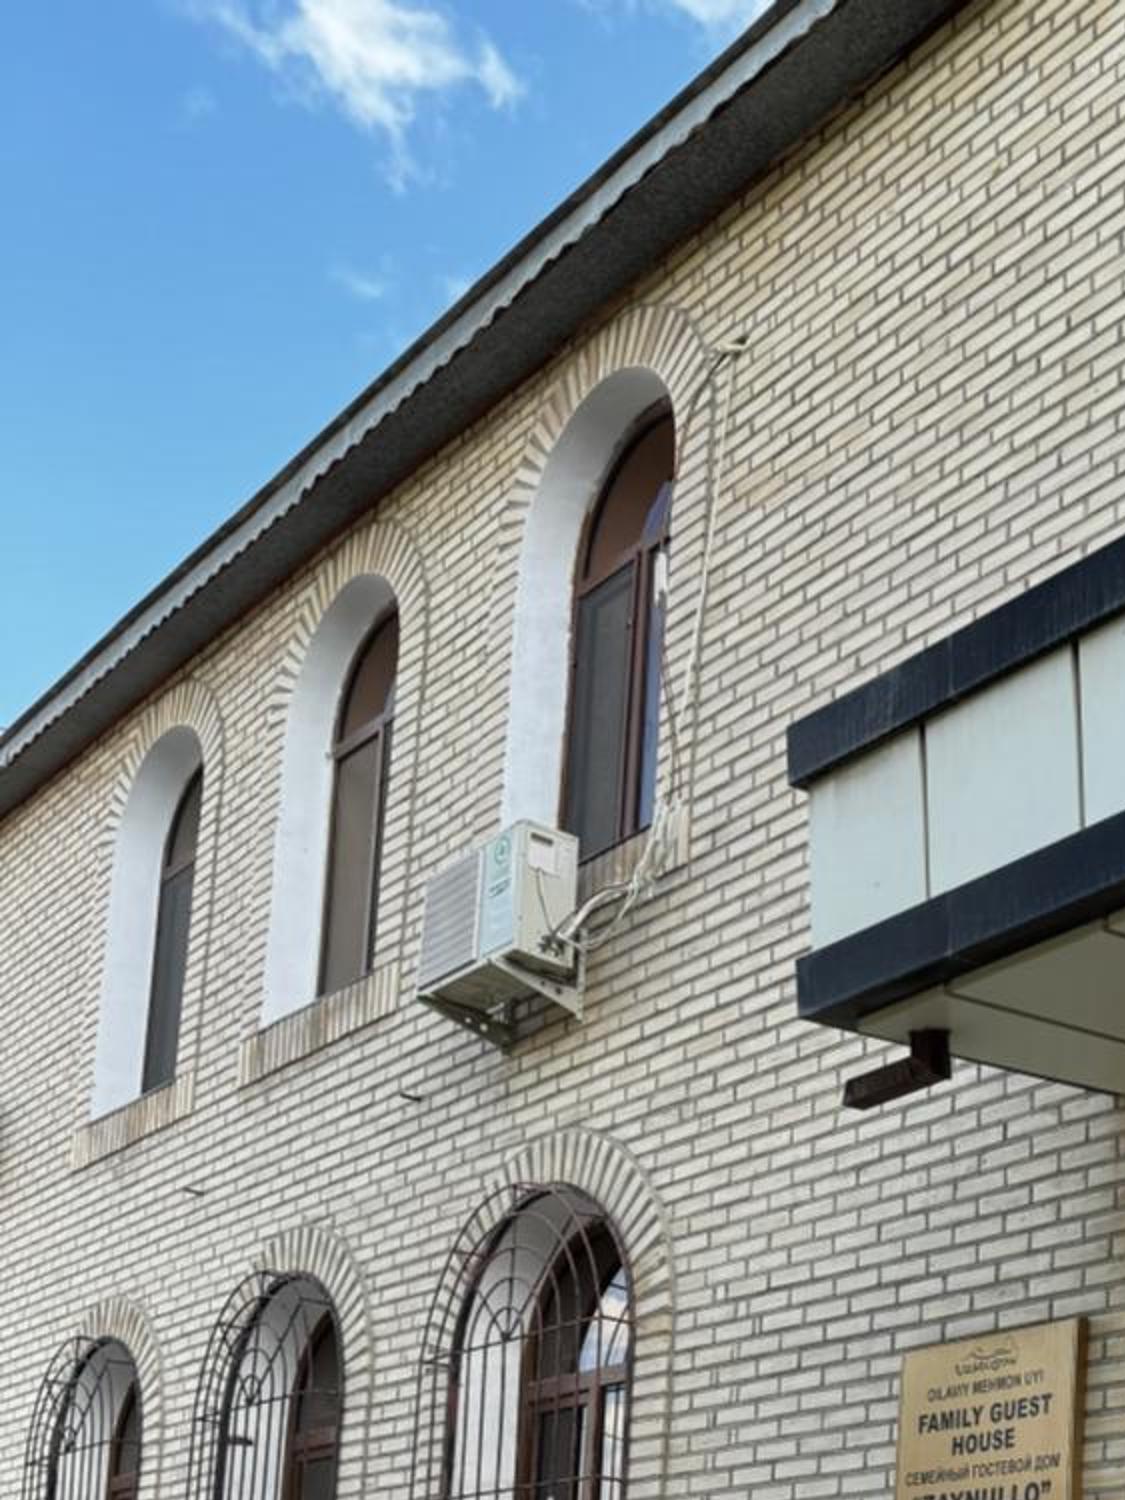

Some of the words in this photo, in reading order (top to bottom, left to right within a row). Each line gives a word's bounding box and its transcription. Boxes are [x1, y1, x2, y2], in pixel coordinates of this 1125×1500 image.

[972, 1373, 1022, 1395] MEHMON
[918, 1405, 984, 1434] FAMILY
[990, 1393, 1053, 1424] GUEST
[951, 1427, 1015, 1456] HOUSE
[904, 1464, 970, 1487] СЕМЕЙНЫЙ
[971, 1453, 1032, 1479] ГОСТЕВОЙ
[1034, 1452, 1061, 1471] ДОМ
